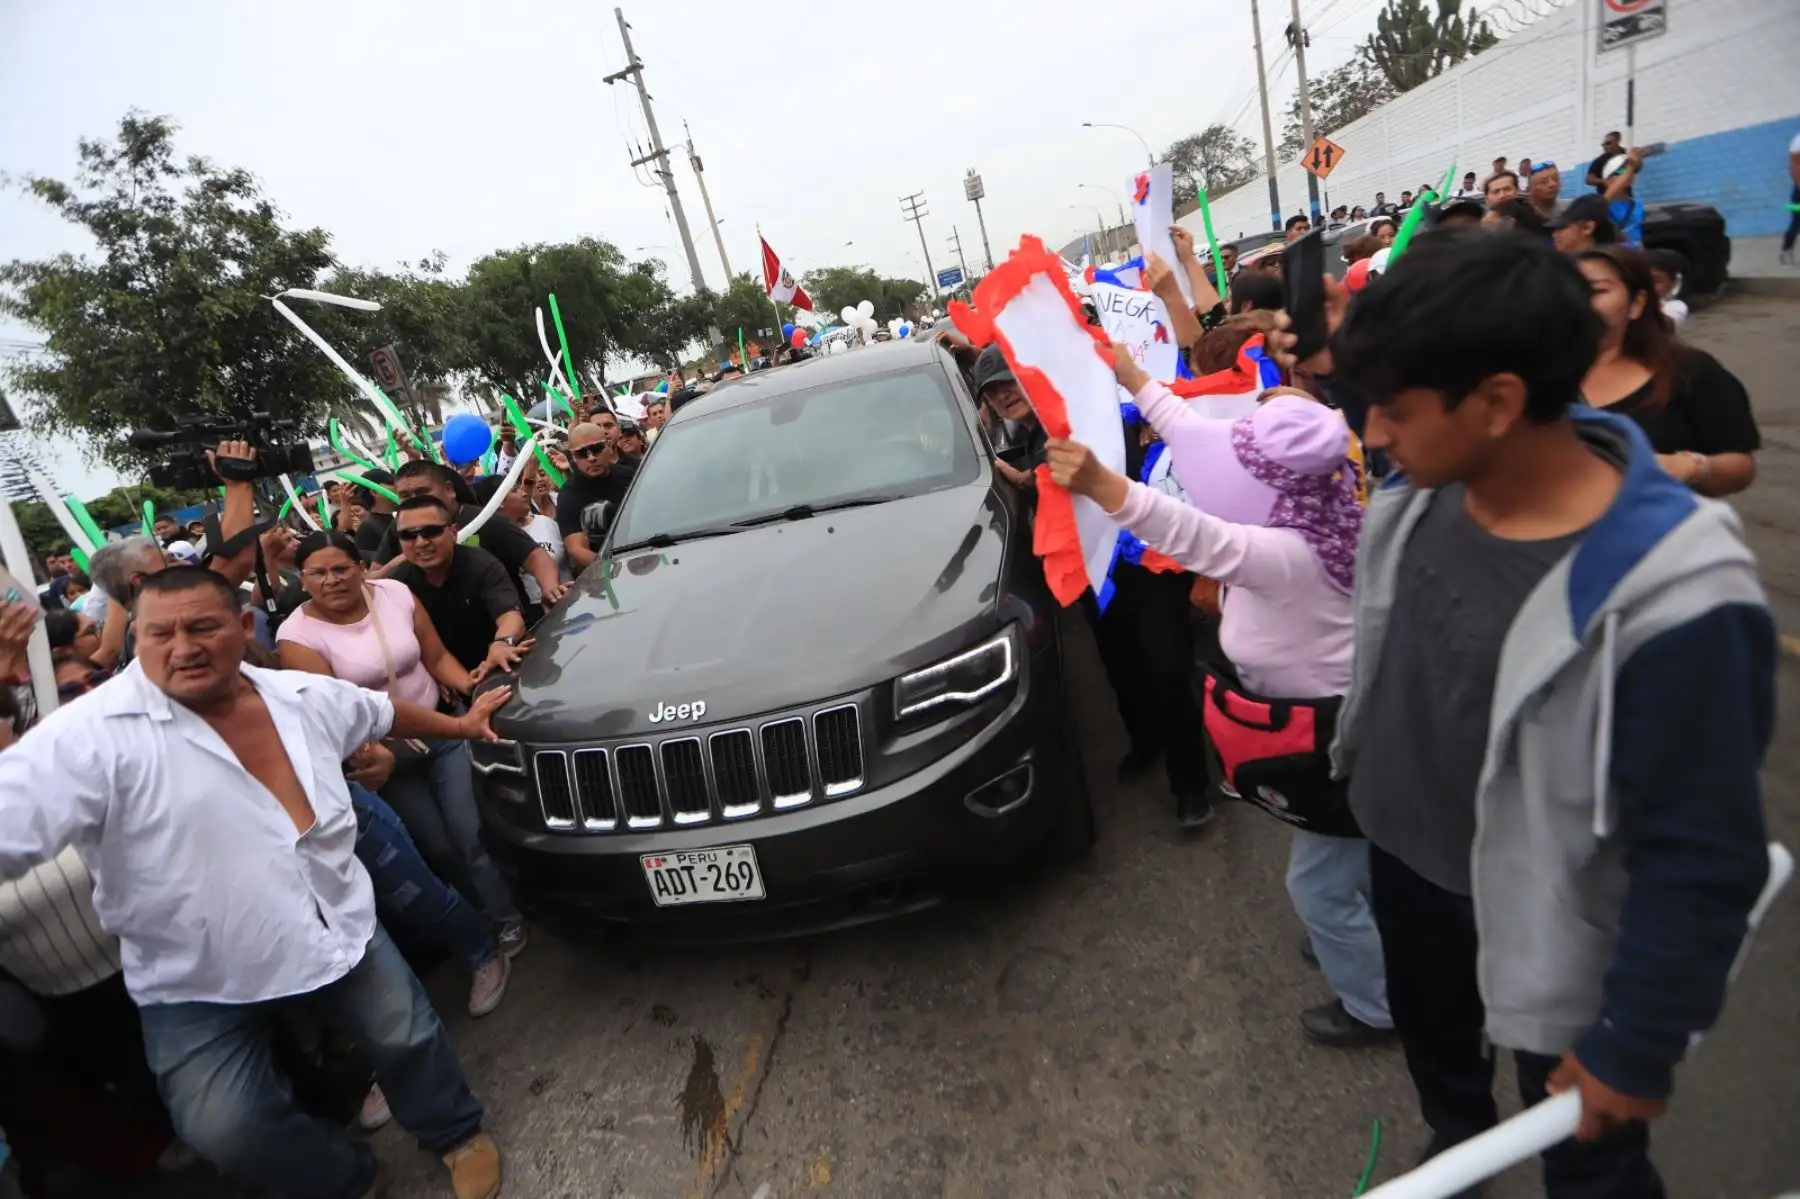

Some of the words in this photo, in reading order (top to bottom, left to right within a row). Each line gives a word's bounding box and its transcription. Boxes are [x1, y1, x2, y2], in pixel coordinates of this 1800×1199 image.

[649, 700, 706, 723] Jeep
[676, 852, 718, 866] PERU
[653, 860, 754, 898] ADT-269
